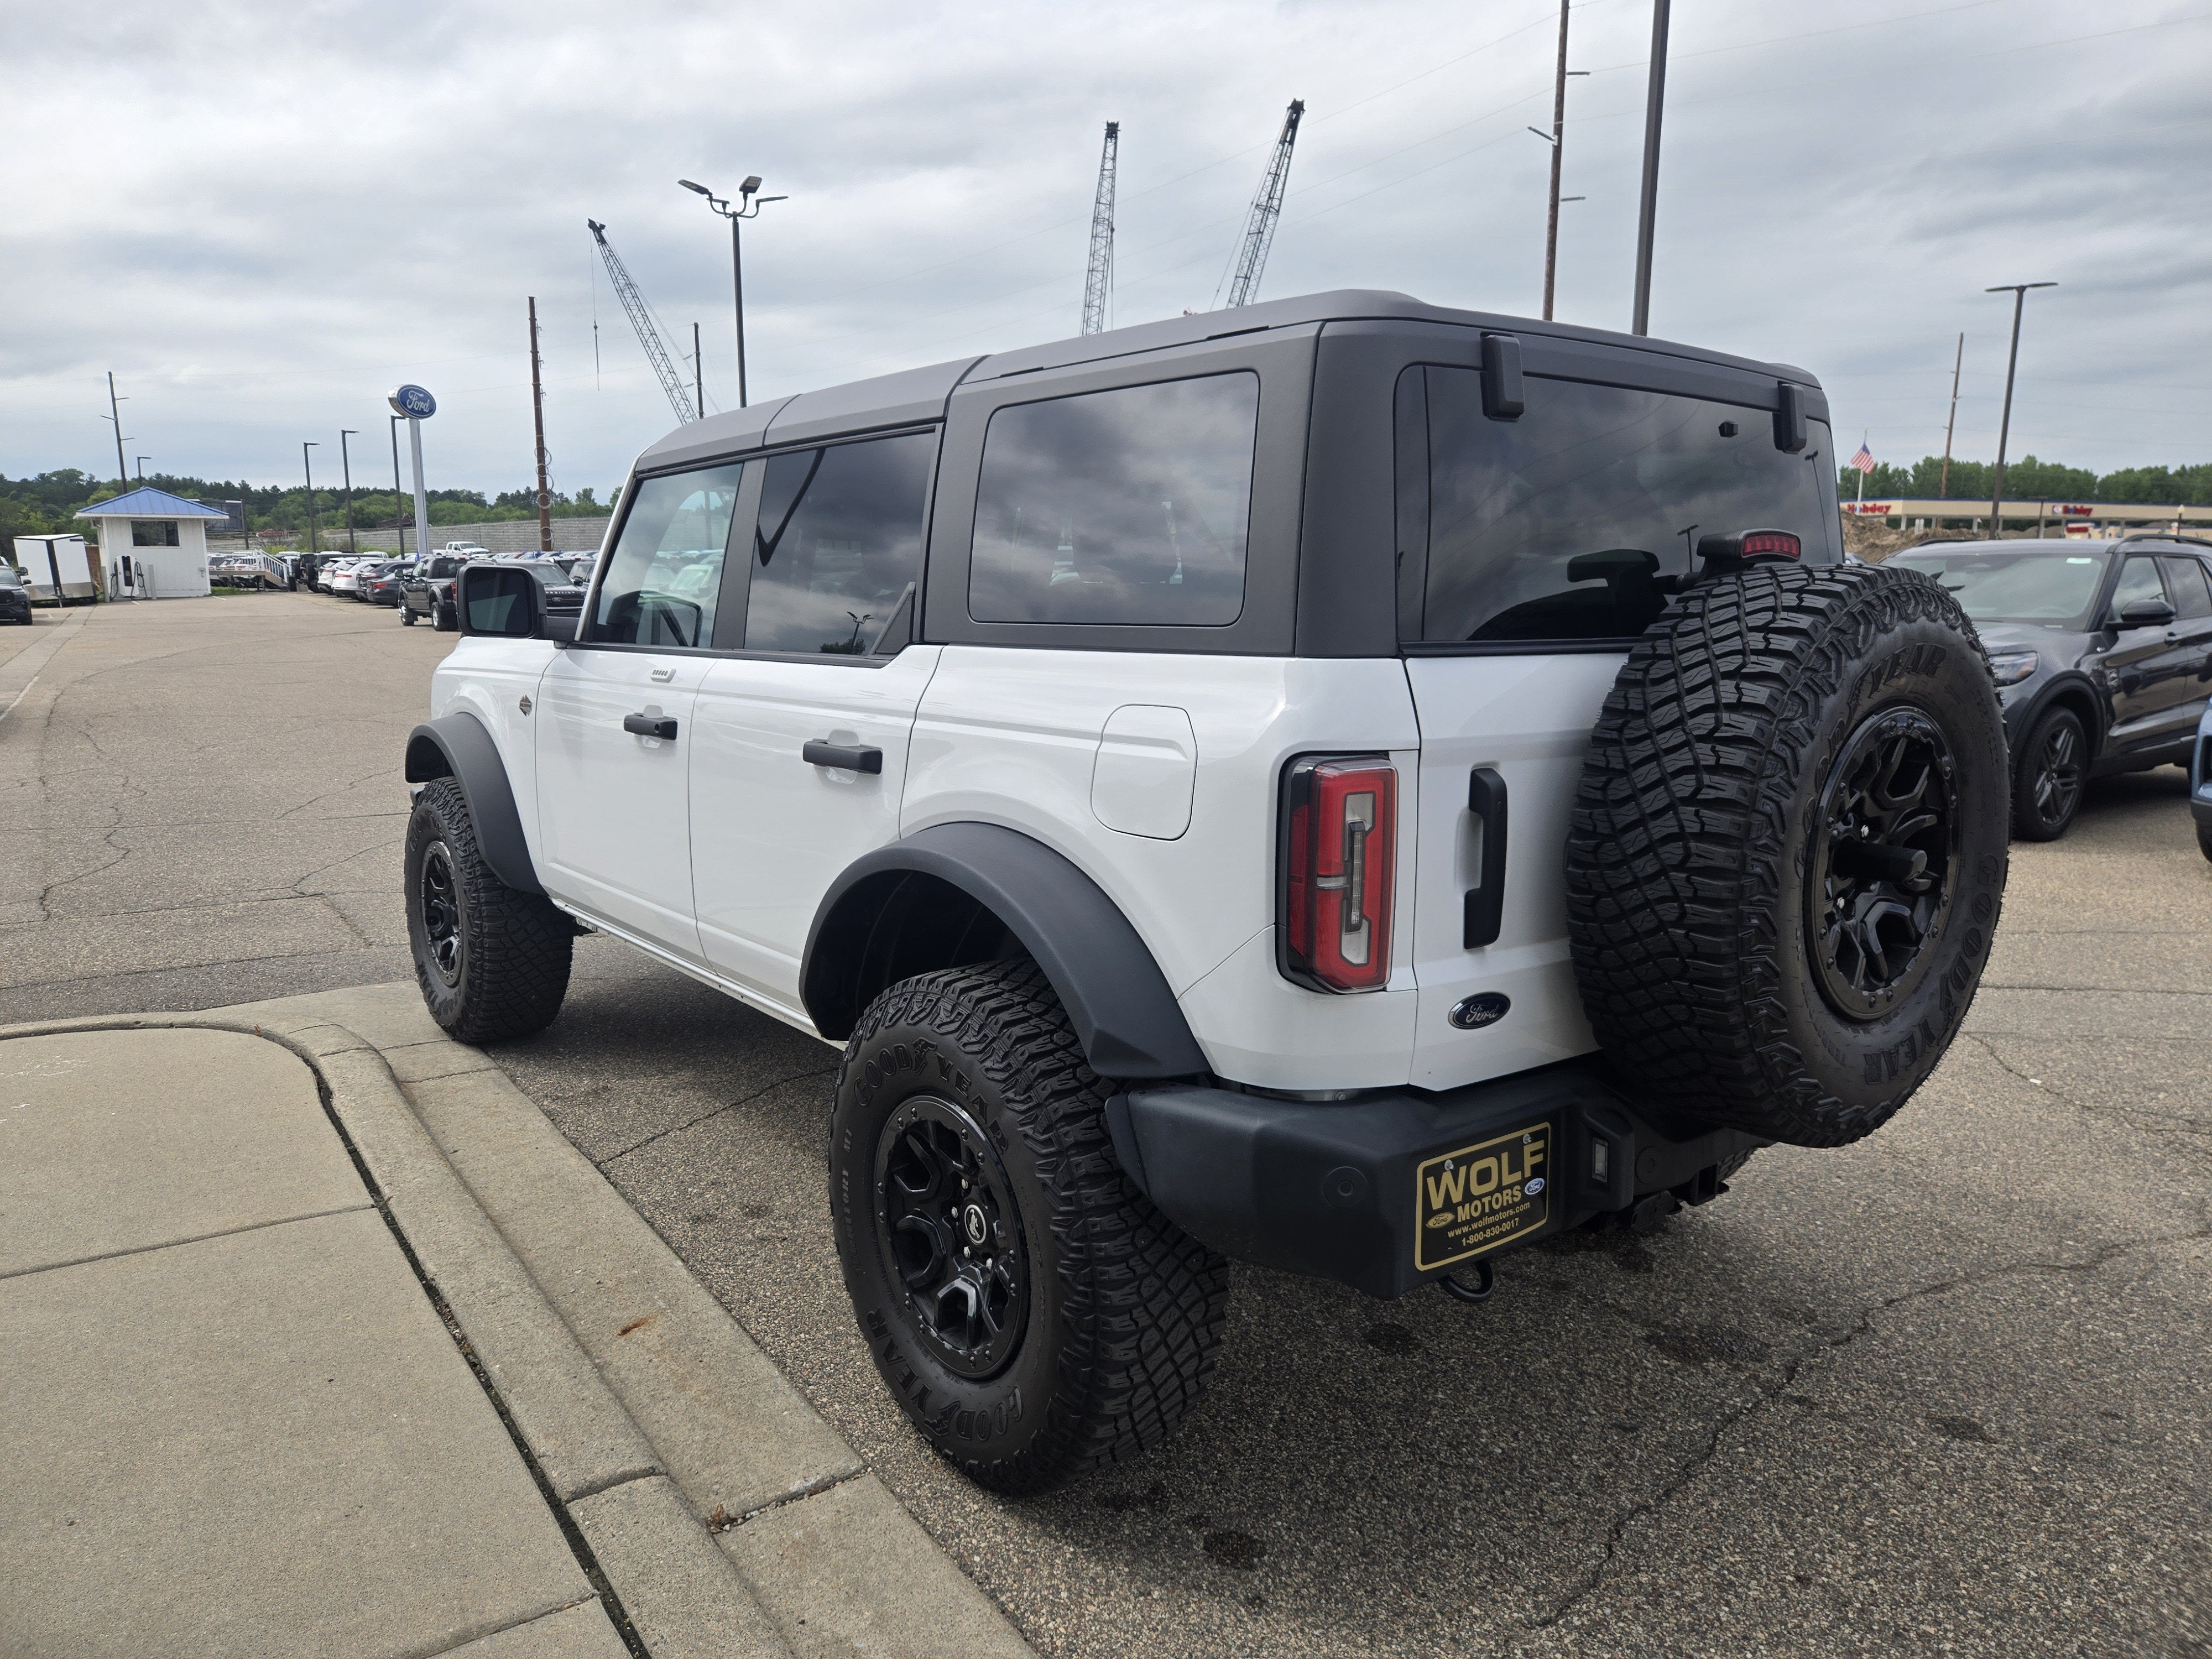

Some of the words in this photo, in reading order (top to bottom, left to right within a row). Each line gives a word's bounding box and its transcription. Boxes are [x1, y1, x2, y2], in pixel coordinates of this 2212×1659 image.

[406, 390, 430, 413] Ford
[1863, 853, 2000, 1085] GOODYEAR
[1465, 1004, 1498, 1023] Ford
[853, 1036, 1010, 1155] GOODYEAR
[1427, 1139, 1544, 1210] WOLF
[1529, 1181, 1541, 1192] Ford
[1433, 1214, 1448, 1225] Ford
[1447, 1201, 1530, 1238] www.wolfmotors.com
[1457, 1185, 1521, 1223] MOTORS
[1462, 1217, 1520, 1246] 1-800-830-0017
[865, 1303, 1024, 1443] GOODYEAR
